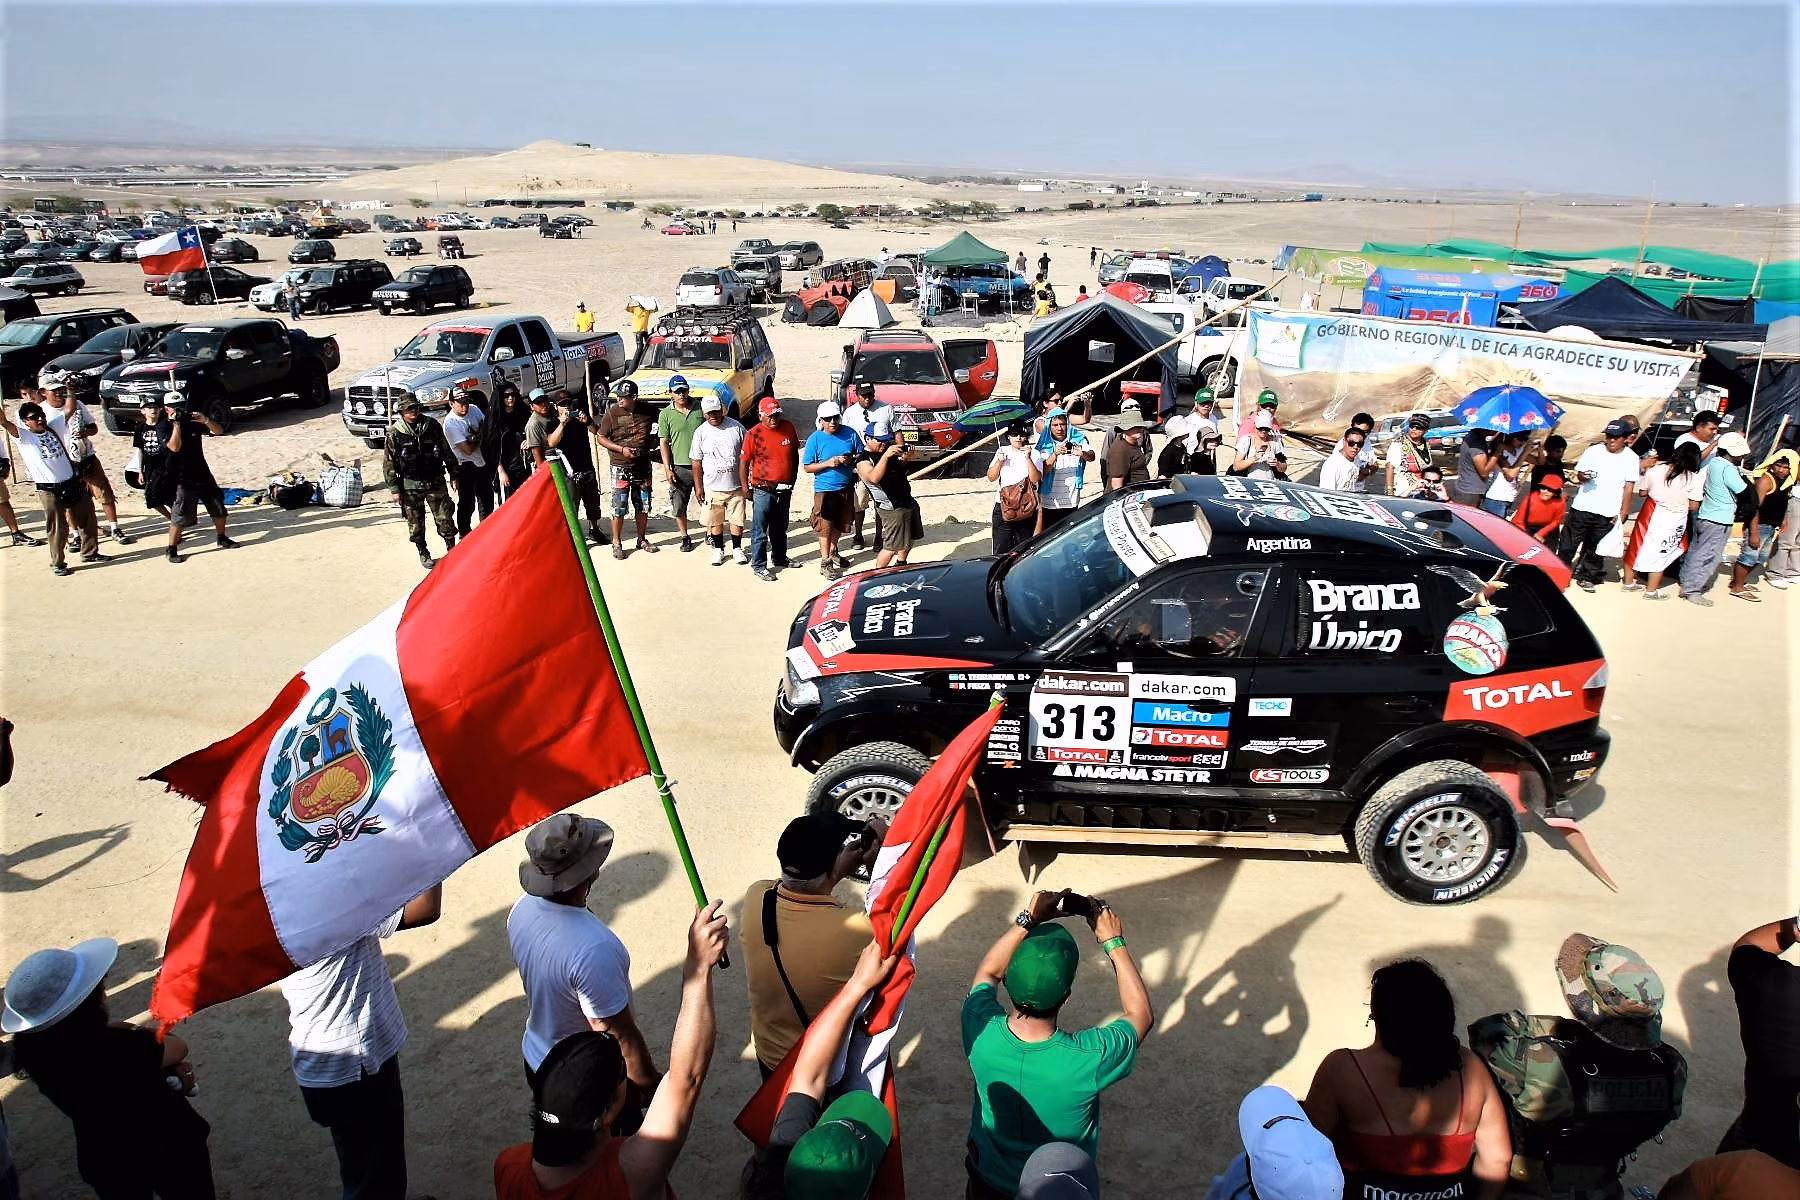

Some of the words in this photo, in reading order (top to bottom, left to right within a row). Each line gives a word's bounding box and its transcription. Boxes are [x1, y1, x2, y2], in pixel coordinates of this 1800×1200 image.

[1519, 284, 1560, 299] 360
[676, 335, 713, 343] TOYOTA
[563, 348, 586, 360] TOTAL
[1316, 323, 1391, 342] GOBIERNO
[1394, 329, 1466, 350] REGIONAL
[1471, 338, 1490, 353] DE
[1494, 341, 1519, 357] ICA
[1522, 345, 1604, 369] AGRADECE
[1607, 356, 1629, 372] SU
[1633, 359, 1681, 378] VISITA
[1117, 532, 1137, 558] Power
[1246, 535, 1312, 554] Argentina
[821, 581, 852, 618] TOTAL
[1307, 579, 1421, 613] Branca
[862, 602, 896, 634] Único
[893, 598, 922, 637] Branca
[1308, 614, 1403, 653] Único
[1038, 675, 1125, 692] dakar.com
[1141, 680, 1226, 696] dakar.com
[1464, 680, 1573, 711] TOTAL
[1042, 703, 1116, 742] 313
[1152, 706, 1213, 723] Macro
[1008, 742, 1020, 751] Q
[1154, 730, 1225, 746] TOTAL
[1051, 749, 1106, 762] TOTAL
[1073, 765, 1150, 782] MAGNA
[1151, 769, 1211, 784] STEYR
[1282, 770, 1322, 780] TOOLS
[1436, 860, 1501, 900] MICHELIN
